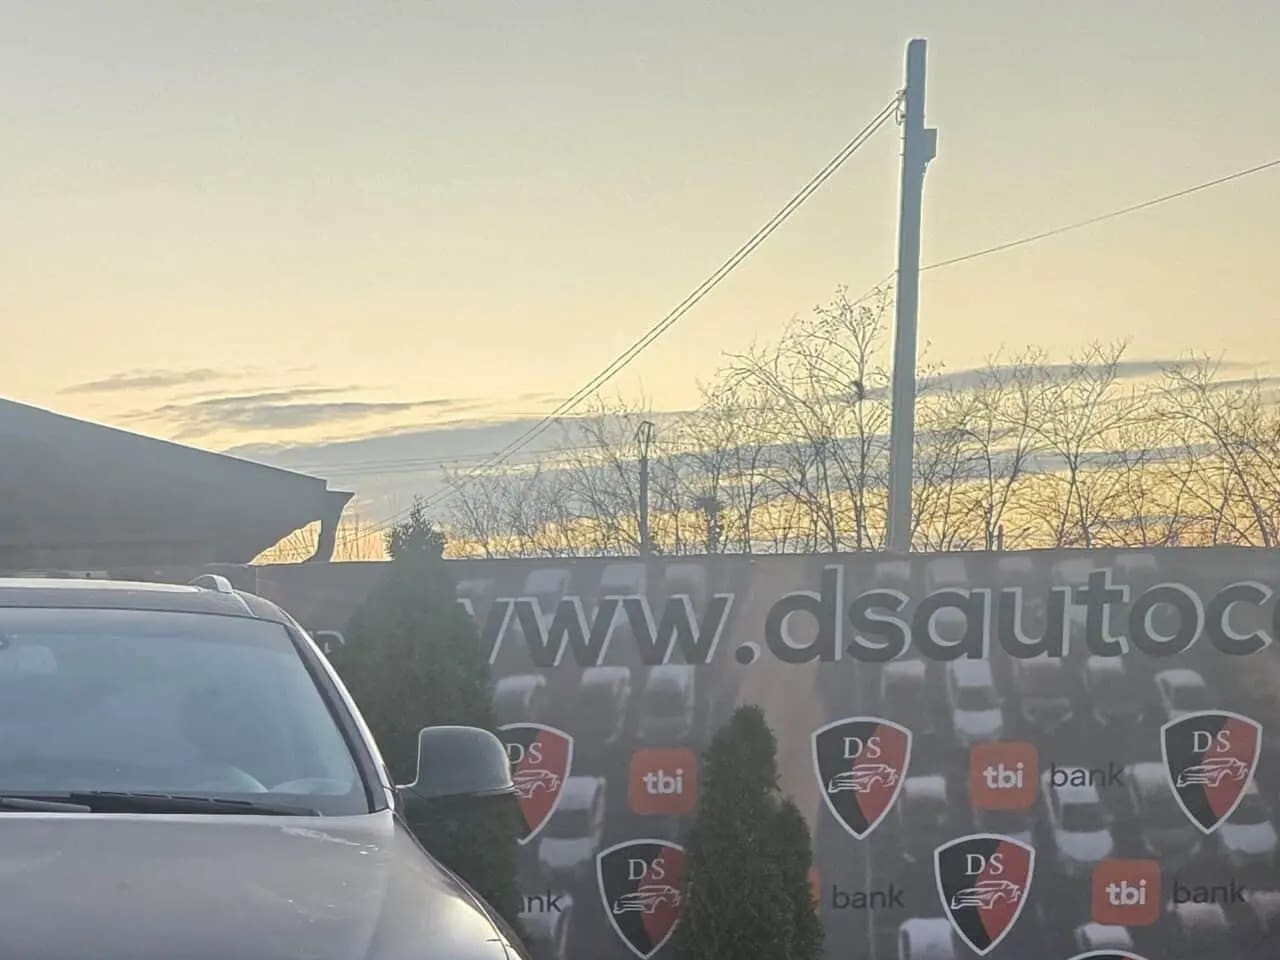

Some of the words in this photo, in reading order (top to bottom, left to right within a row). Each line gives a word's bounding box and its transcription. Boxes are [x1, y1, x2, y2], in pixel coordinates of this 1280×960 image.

[457, 564, 1280, 666] ww.dsautoc
[507, 742, 543, 765] DS
[843, 736, 881, 759] DS
[1192, 730, 1231, 753] DS
[642, 768, 683, 794] tbi
[983, 762, 1024, 789] tbi
[1050, 762, 1125, 788] bank
[628, 859, 665, 881] DS
[965, 854, 1004, 876] DS
[521, 889, 562, 914] nk
[832, 884, 905, 909] bank
[1105, 879, 1147, 905] tbi
[1173, 877, 1246, 904] bank
